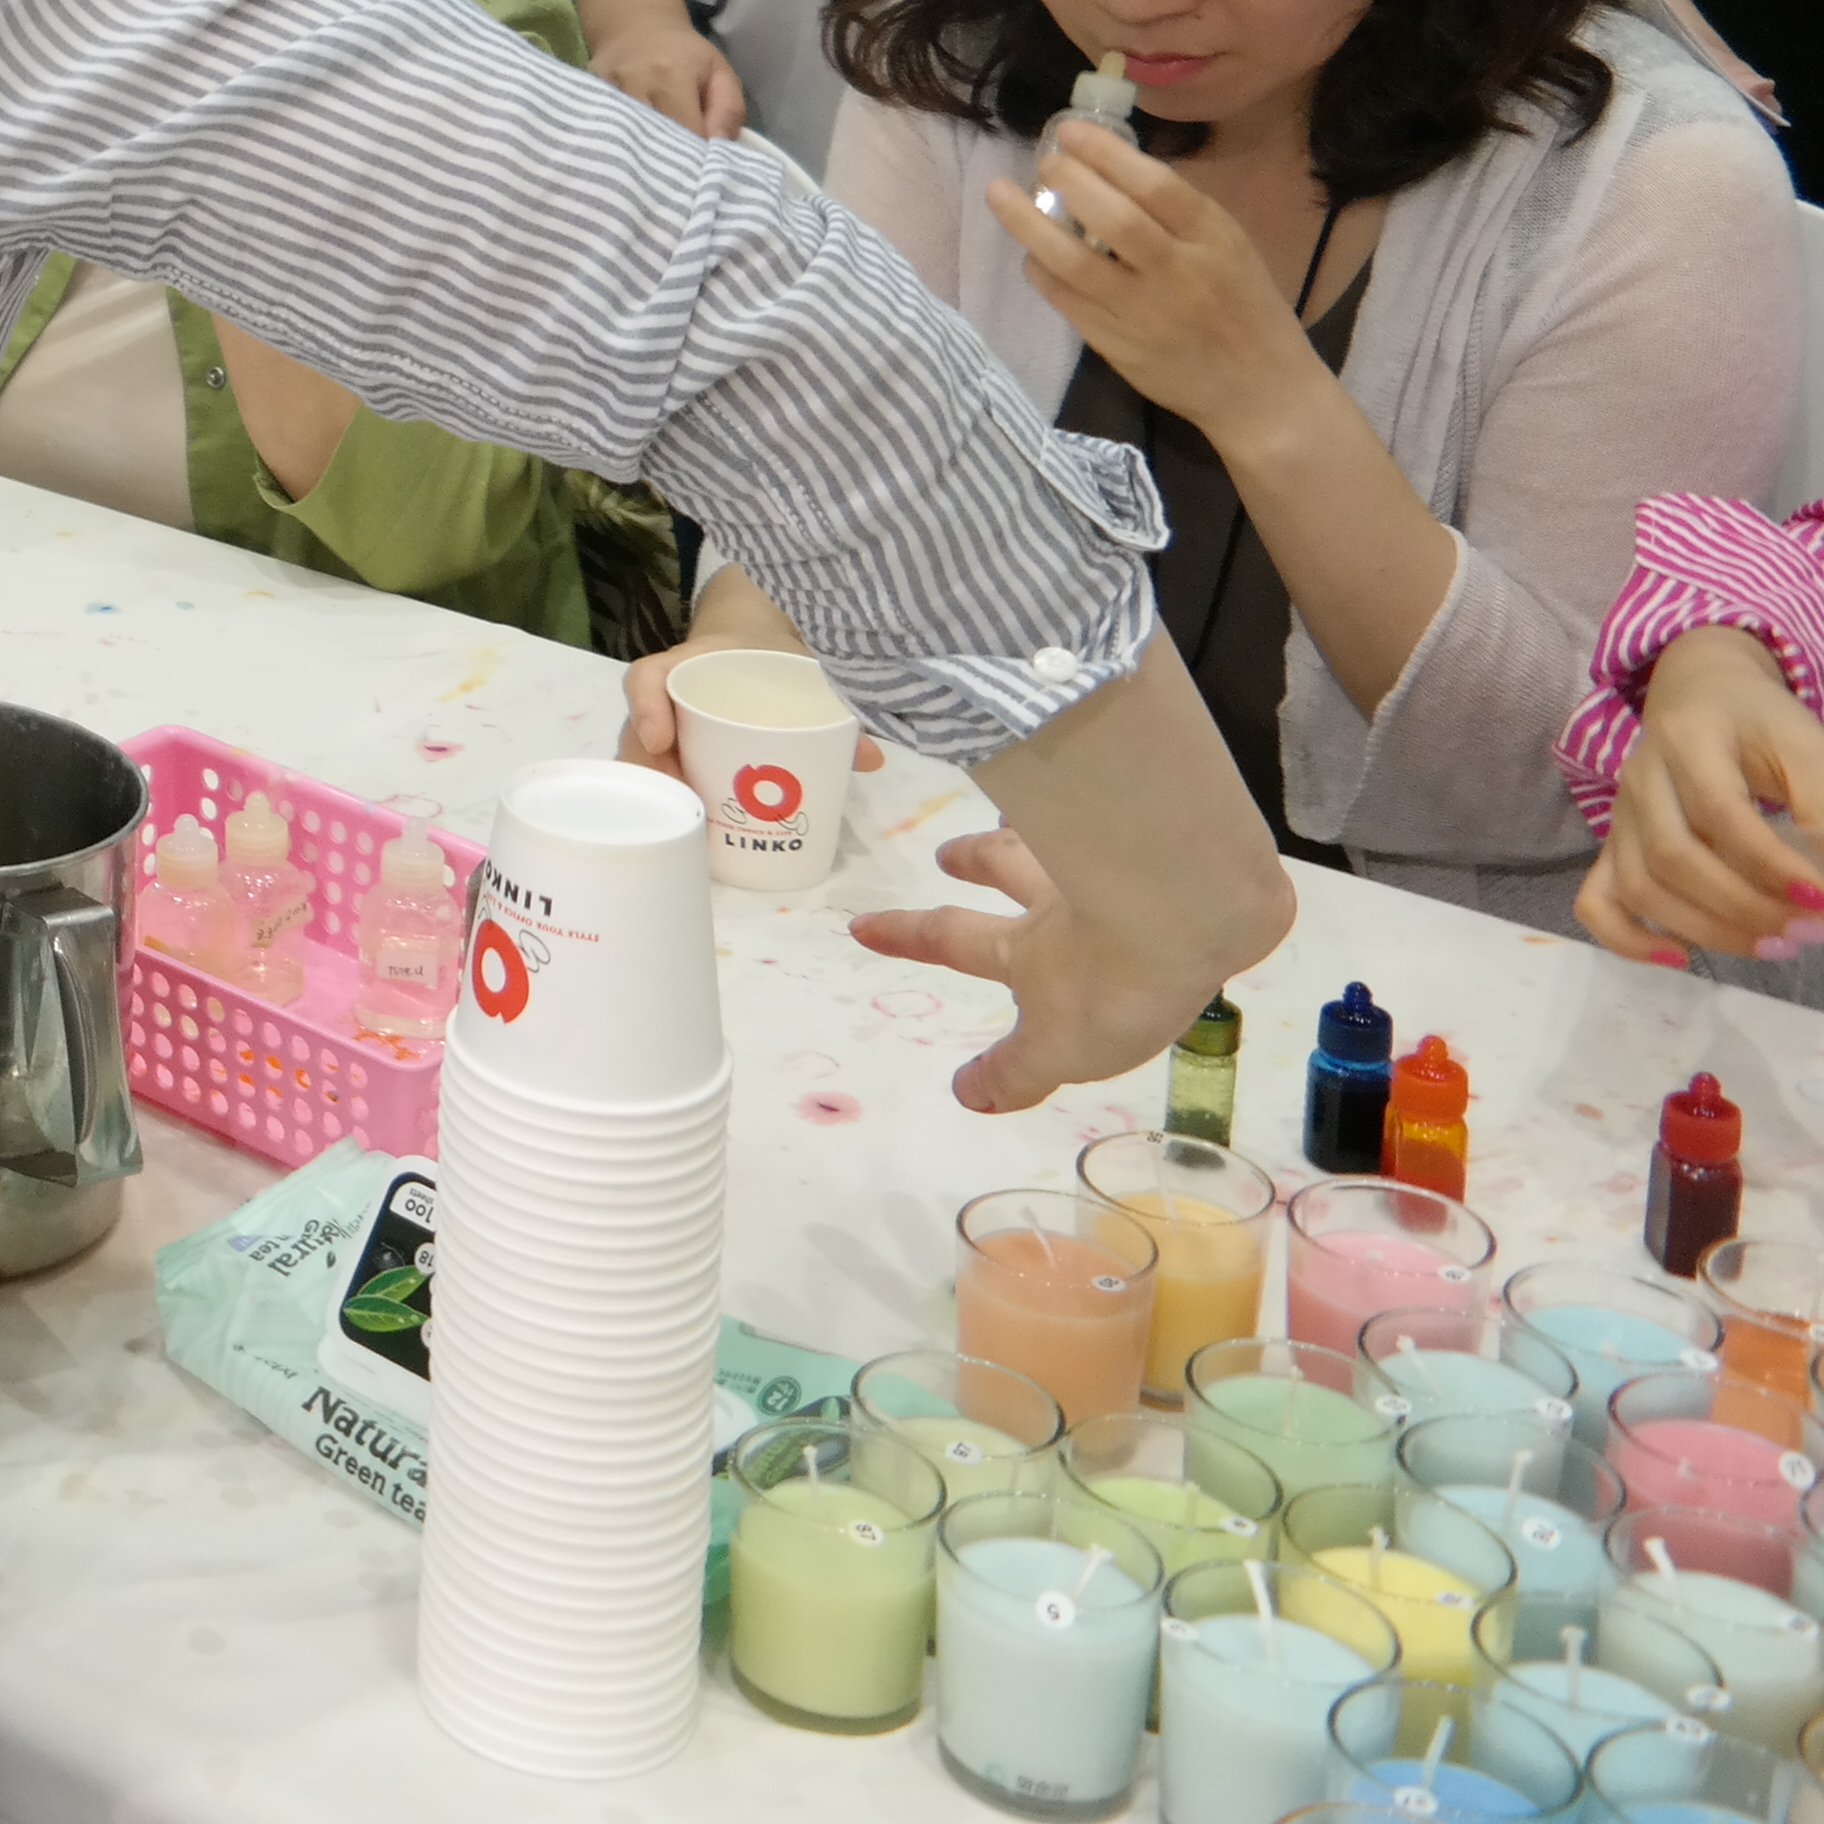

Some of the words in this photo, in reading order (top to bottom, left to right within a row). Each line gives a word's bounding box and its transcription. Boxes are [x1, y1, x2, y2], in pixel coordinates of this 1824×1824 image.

[724, 833, 803, 852] LINKO
[484, 859, 553, 917] LINKO
[315, 1433, 387, 1496] Green
[391, 1482, 426, 1524] tea
